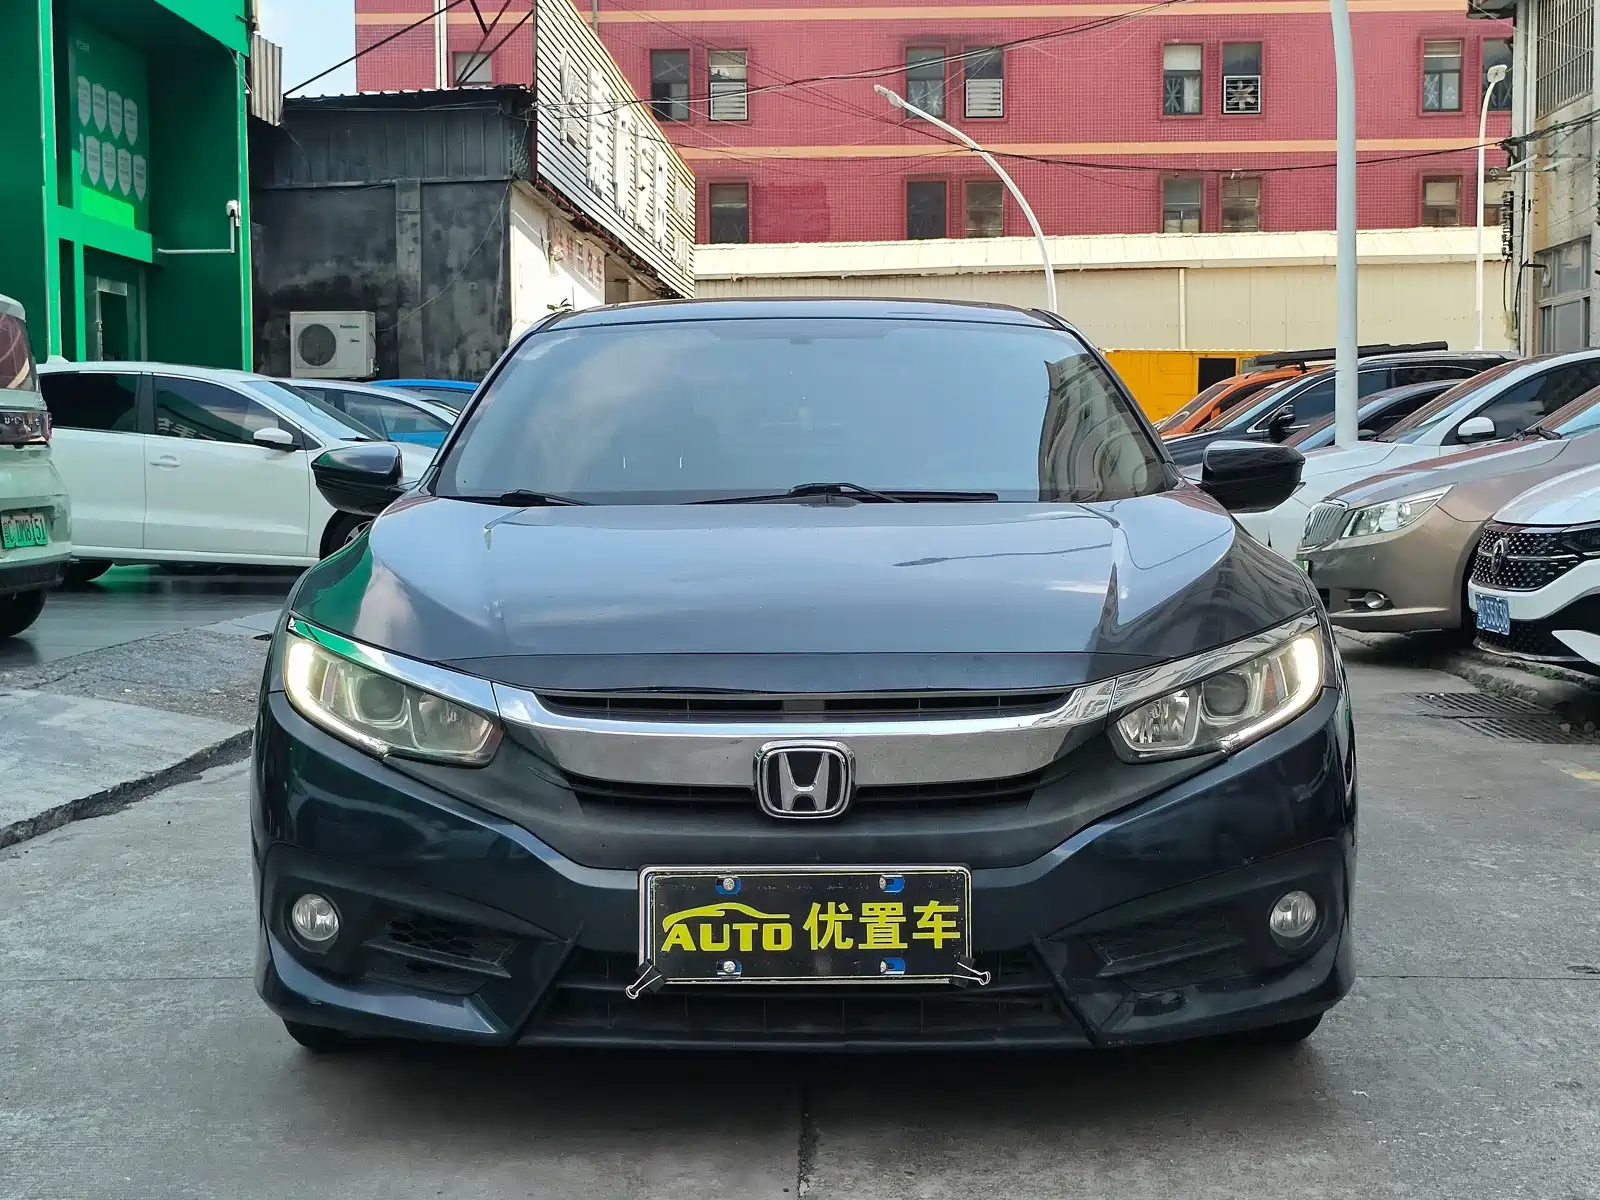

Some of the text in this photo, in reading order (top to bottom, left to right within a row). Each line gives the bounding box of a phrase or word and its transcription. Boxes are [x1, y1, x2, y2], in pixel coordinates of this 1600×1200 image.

[778, 752, 830, 812] H
[661, 900, 961, 952] AUTO 优置车
